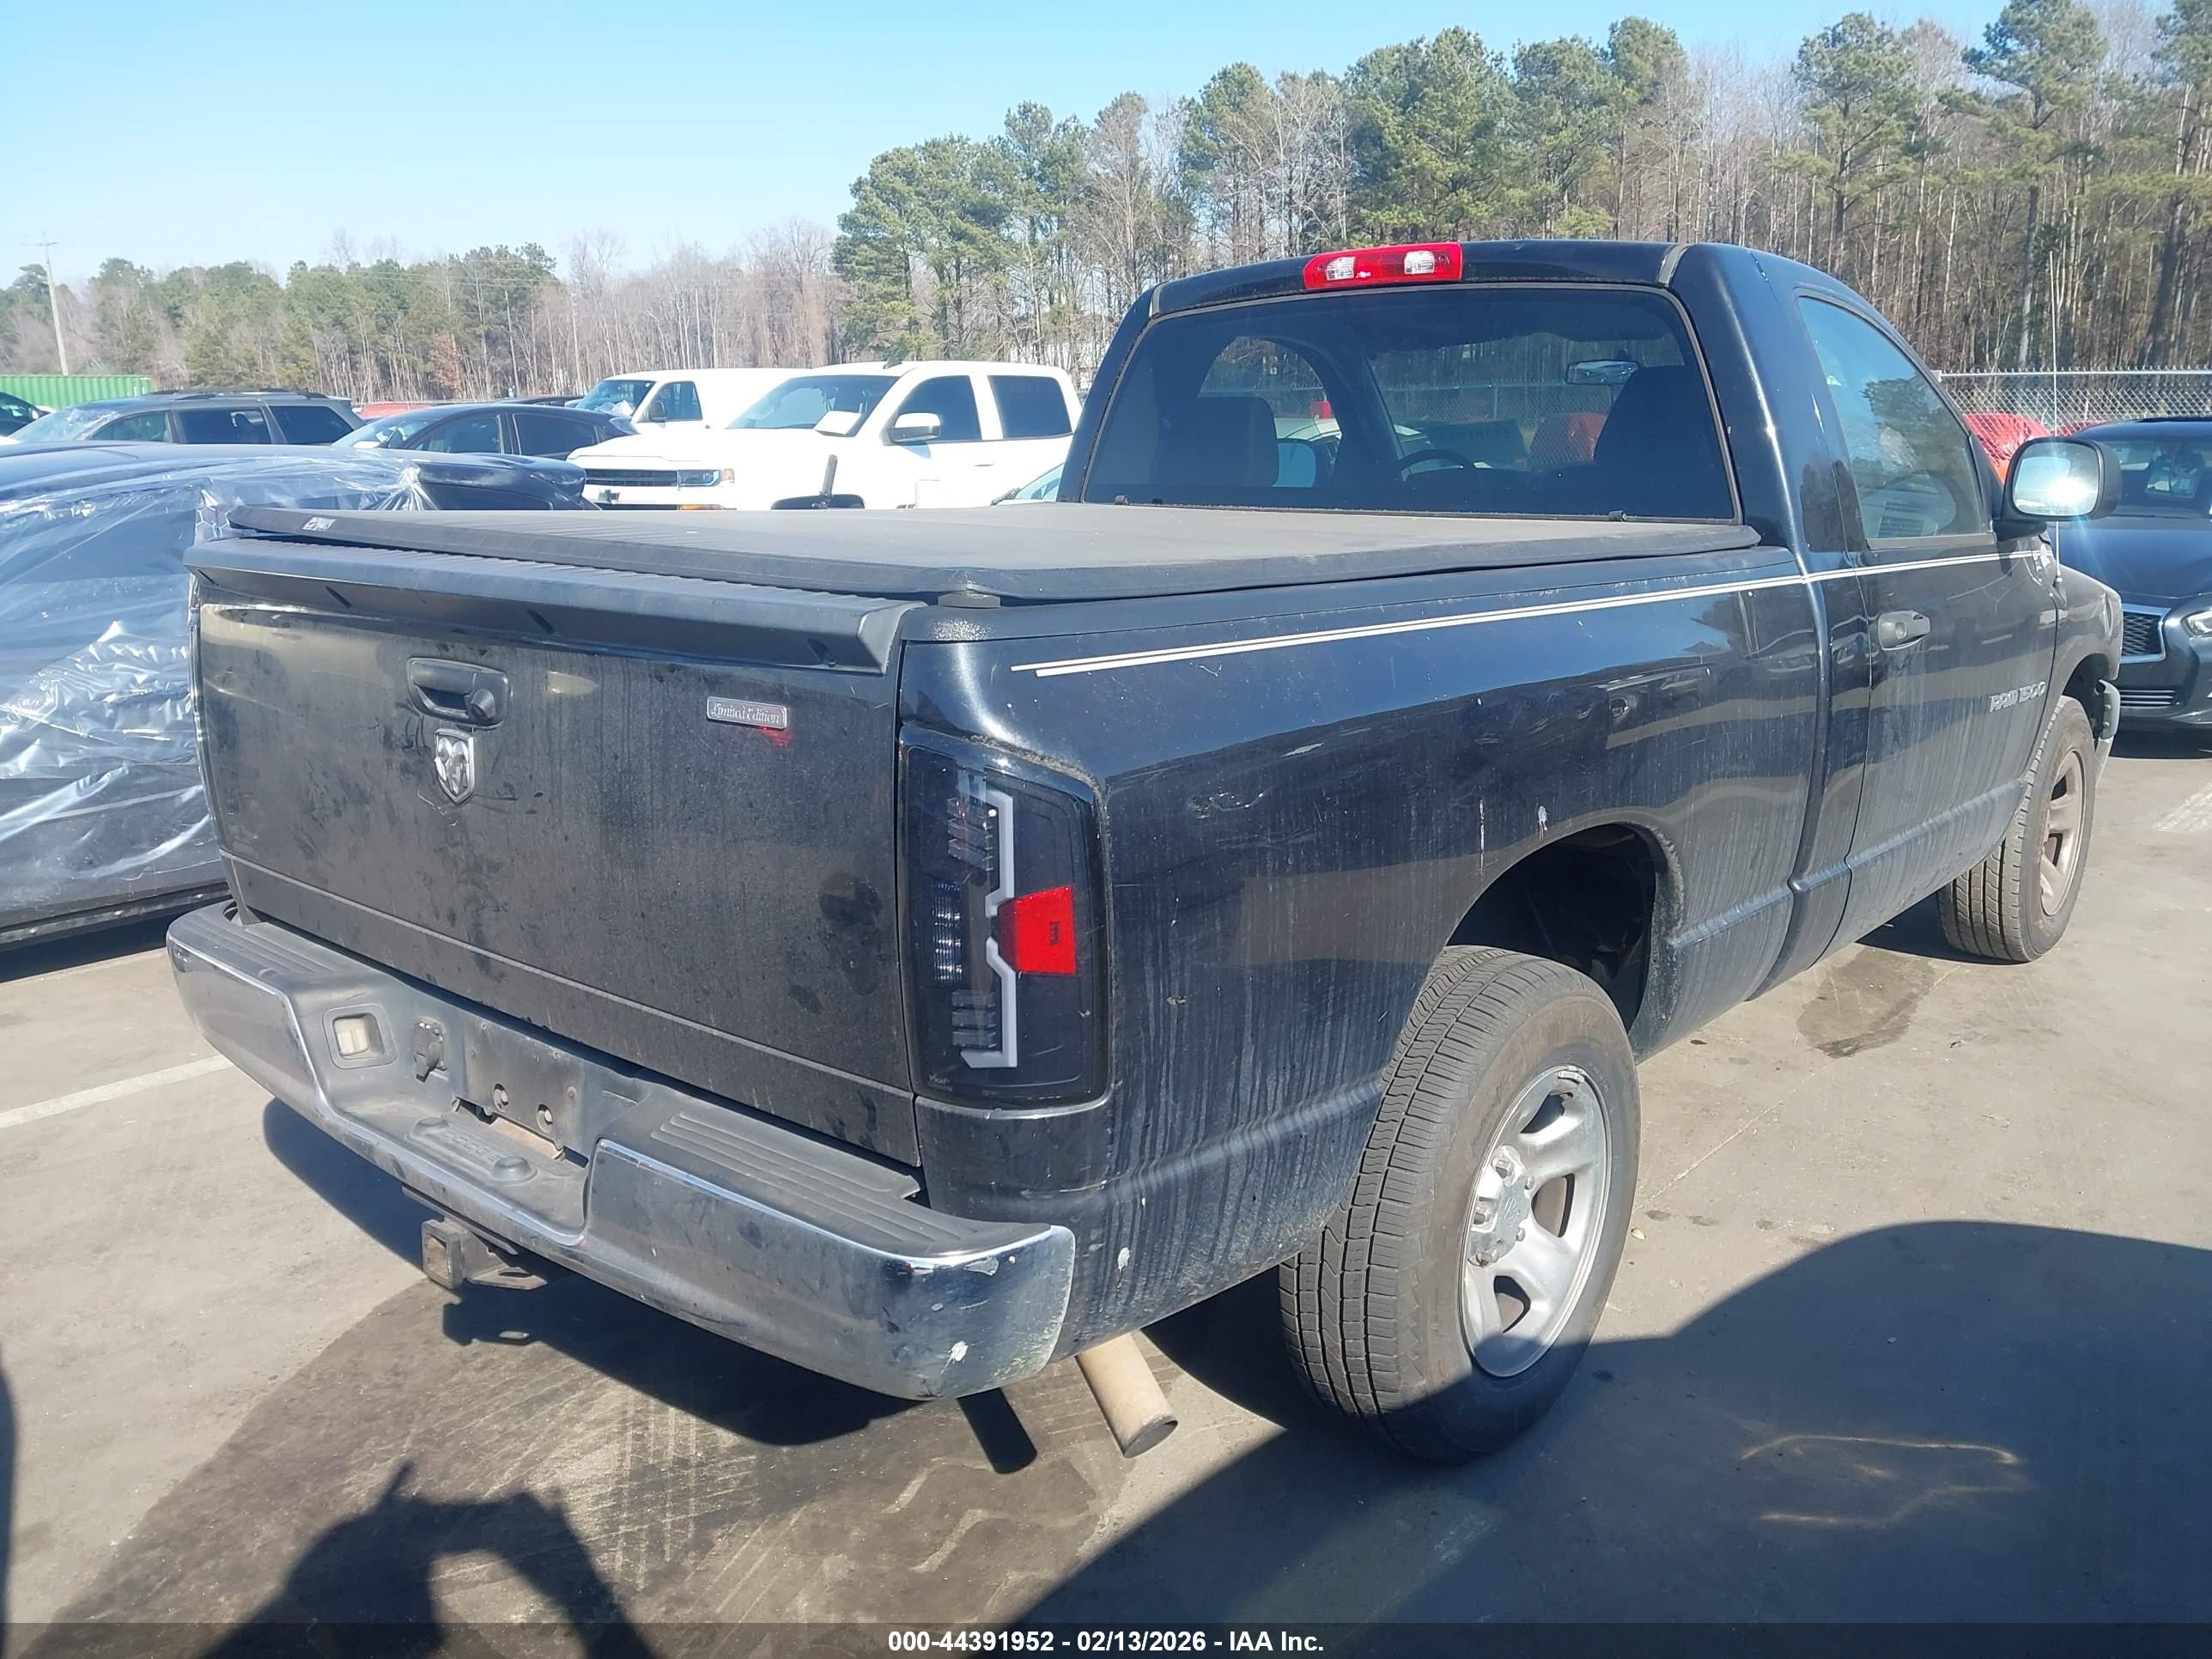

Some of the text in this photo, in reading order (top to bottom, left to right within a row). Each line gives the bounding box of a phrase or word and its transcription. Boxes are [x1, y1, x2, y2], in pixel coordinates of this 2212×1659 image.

[1990, 681, 2046, 712] RAM 1500
[711, 702, 780, 724] Limited Edition
